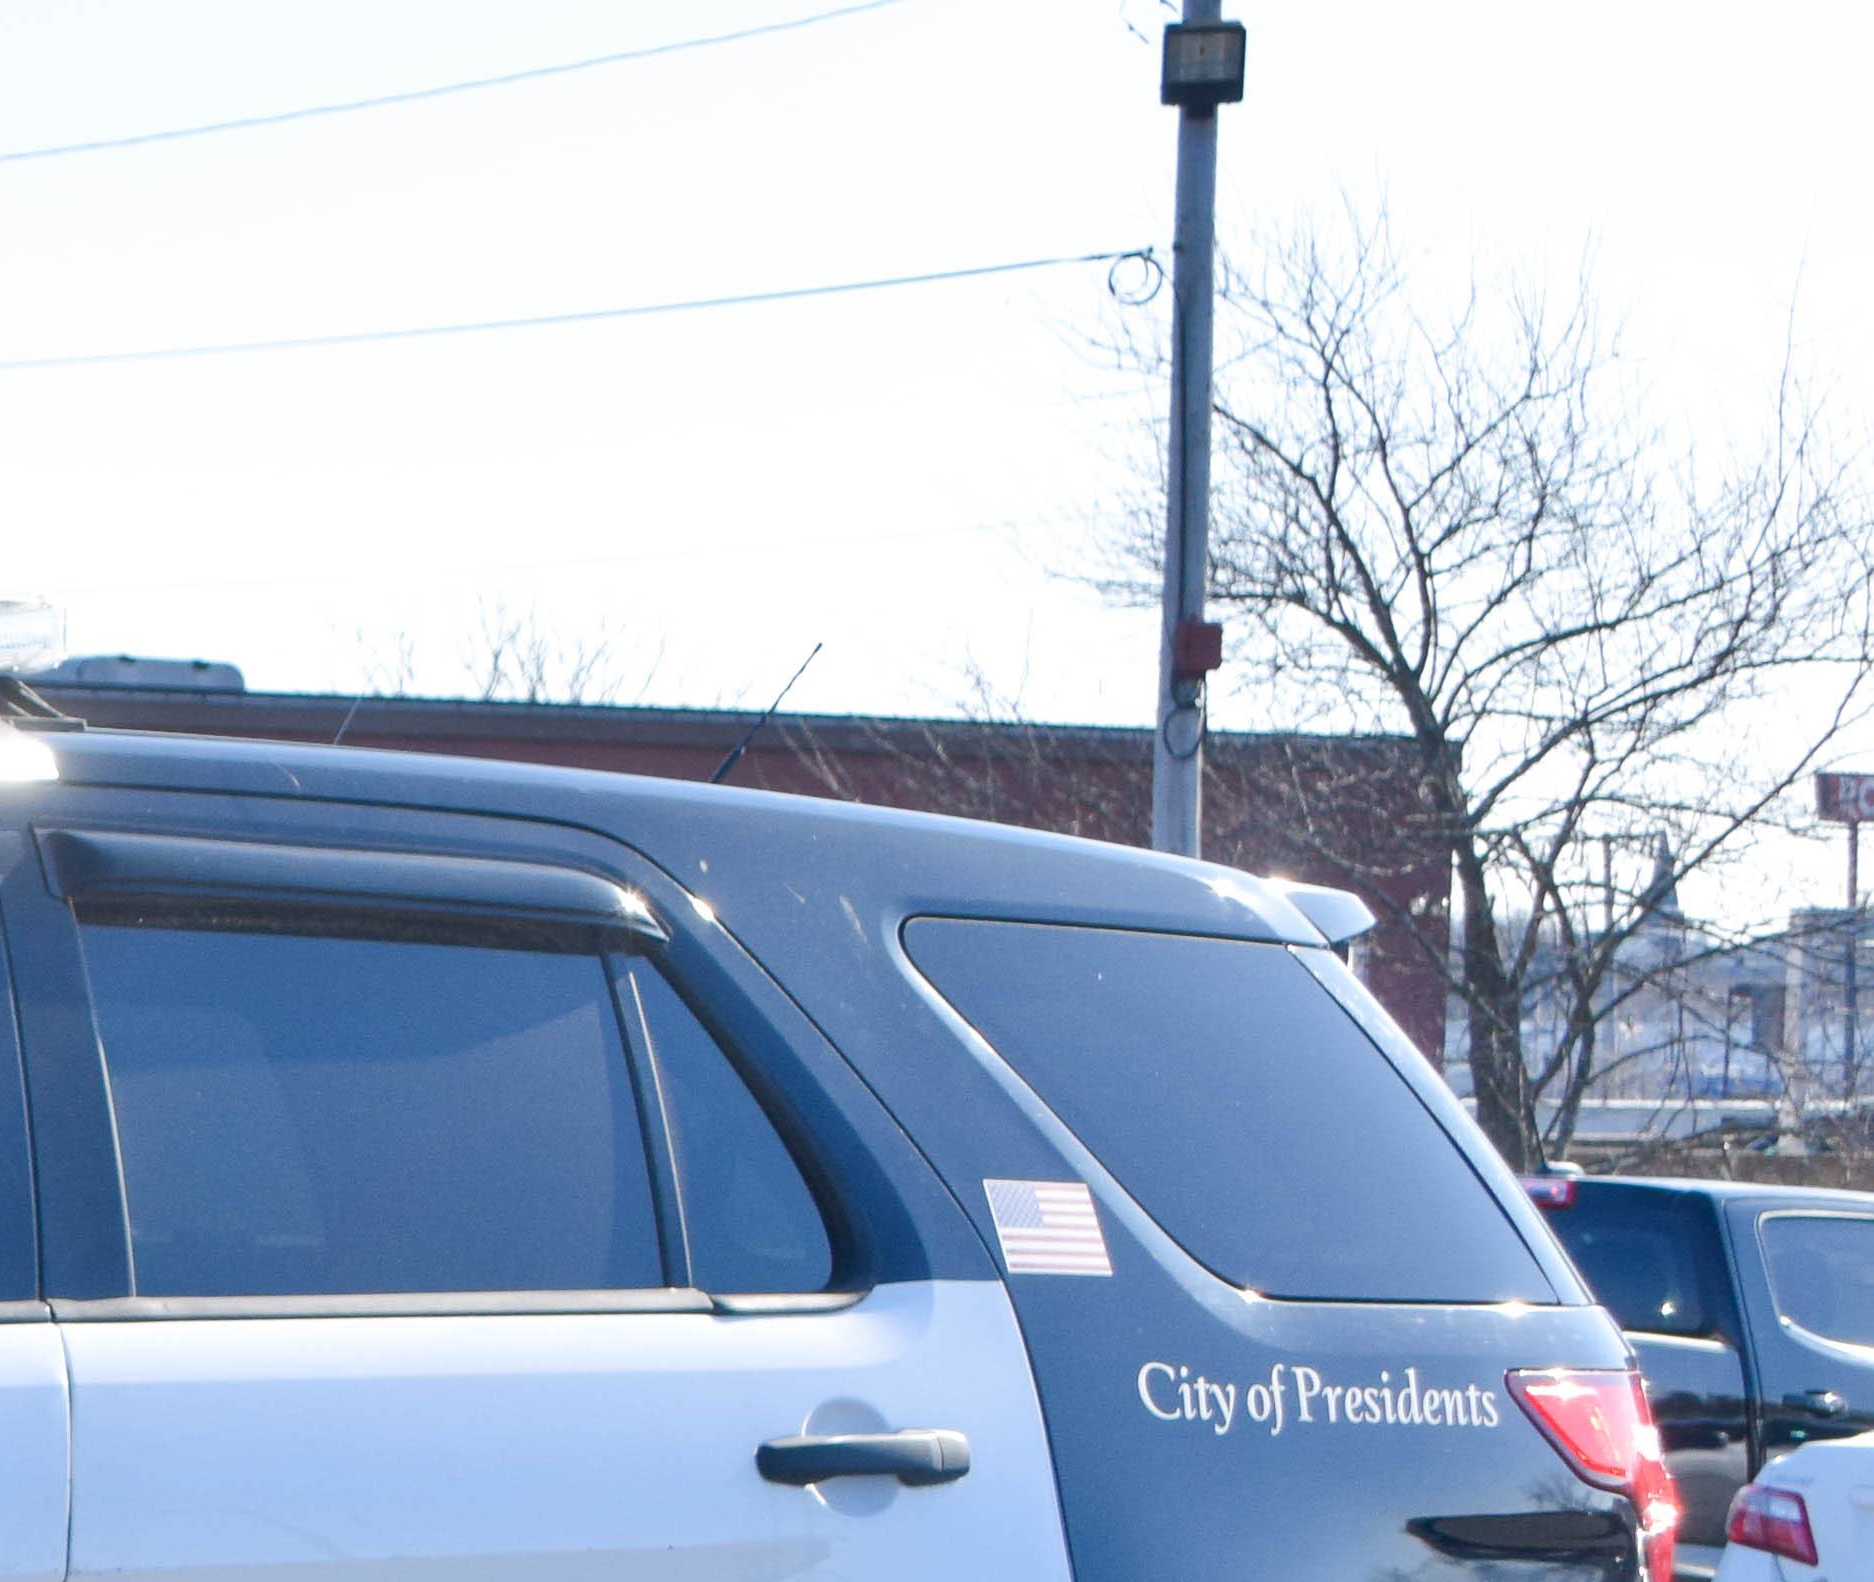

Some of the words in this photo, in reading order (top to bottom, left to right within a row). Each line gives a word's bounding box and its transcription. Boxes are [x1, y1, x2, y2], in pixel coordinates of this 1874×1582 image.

[1137, 1362, 1235, 1435] City
[1247, 1363, 1285, 1436] of
[1290, 1365, 1499, 1428] Presidents
